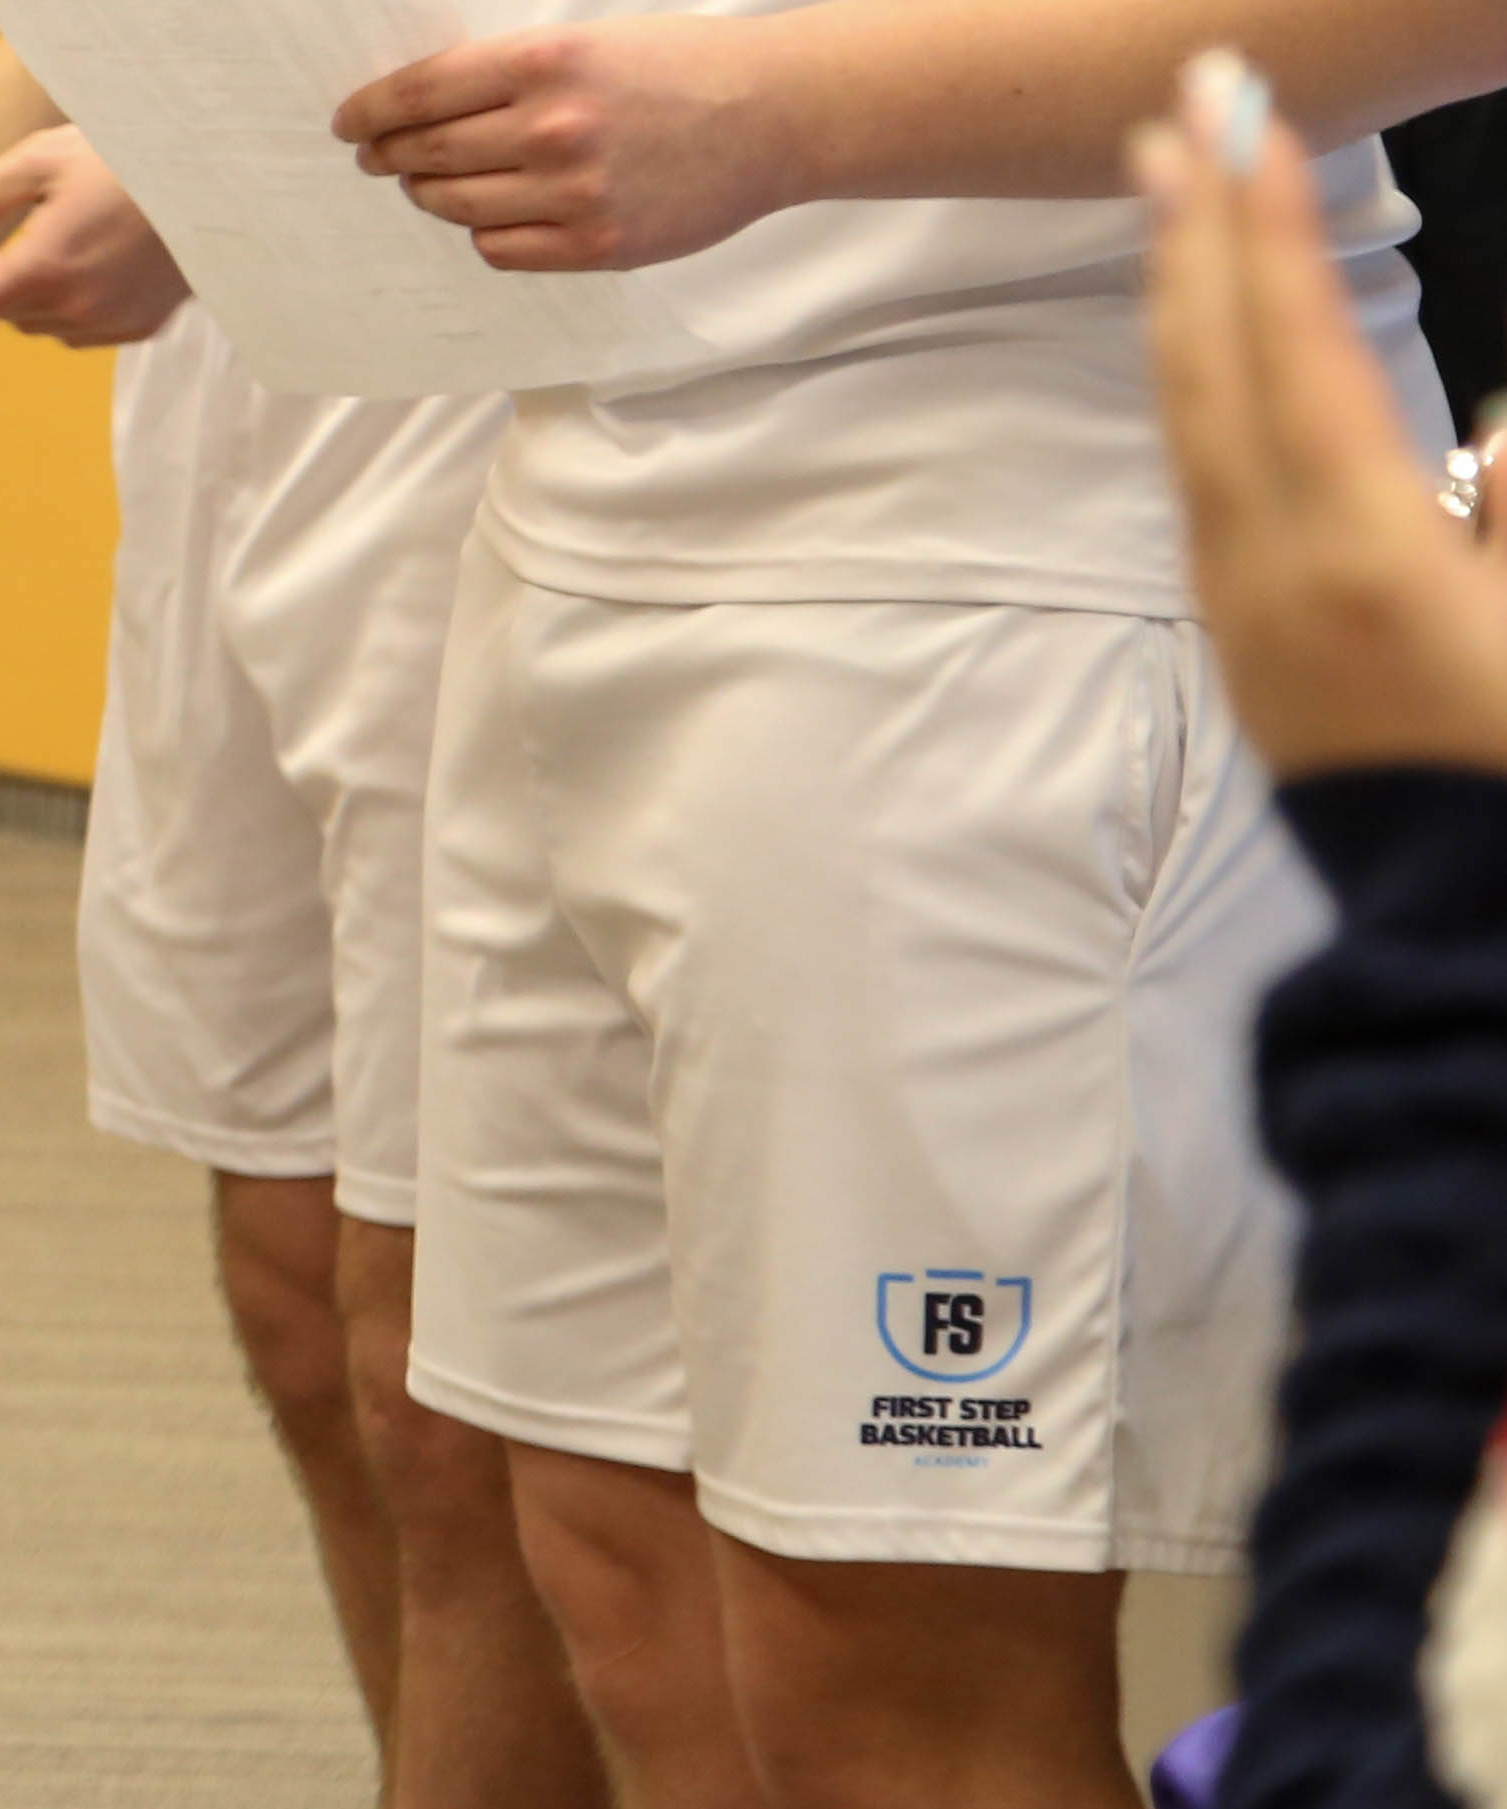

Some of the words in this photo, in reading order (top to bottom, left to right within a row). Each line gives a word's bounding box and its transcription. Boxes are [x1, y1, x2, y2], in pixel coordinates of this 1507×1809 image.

[923, 1292, 984, 1355] FS
[871, 1395, 953, 1419] FIRST
[959, 1398, 1031, 1421] STEP
[859, 1423, 1043, 1450] BASKETBALL
